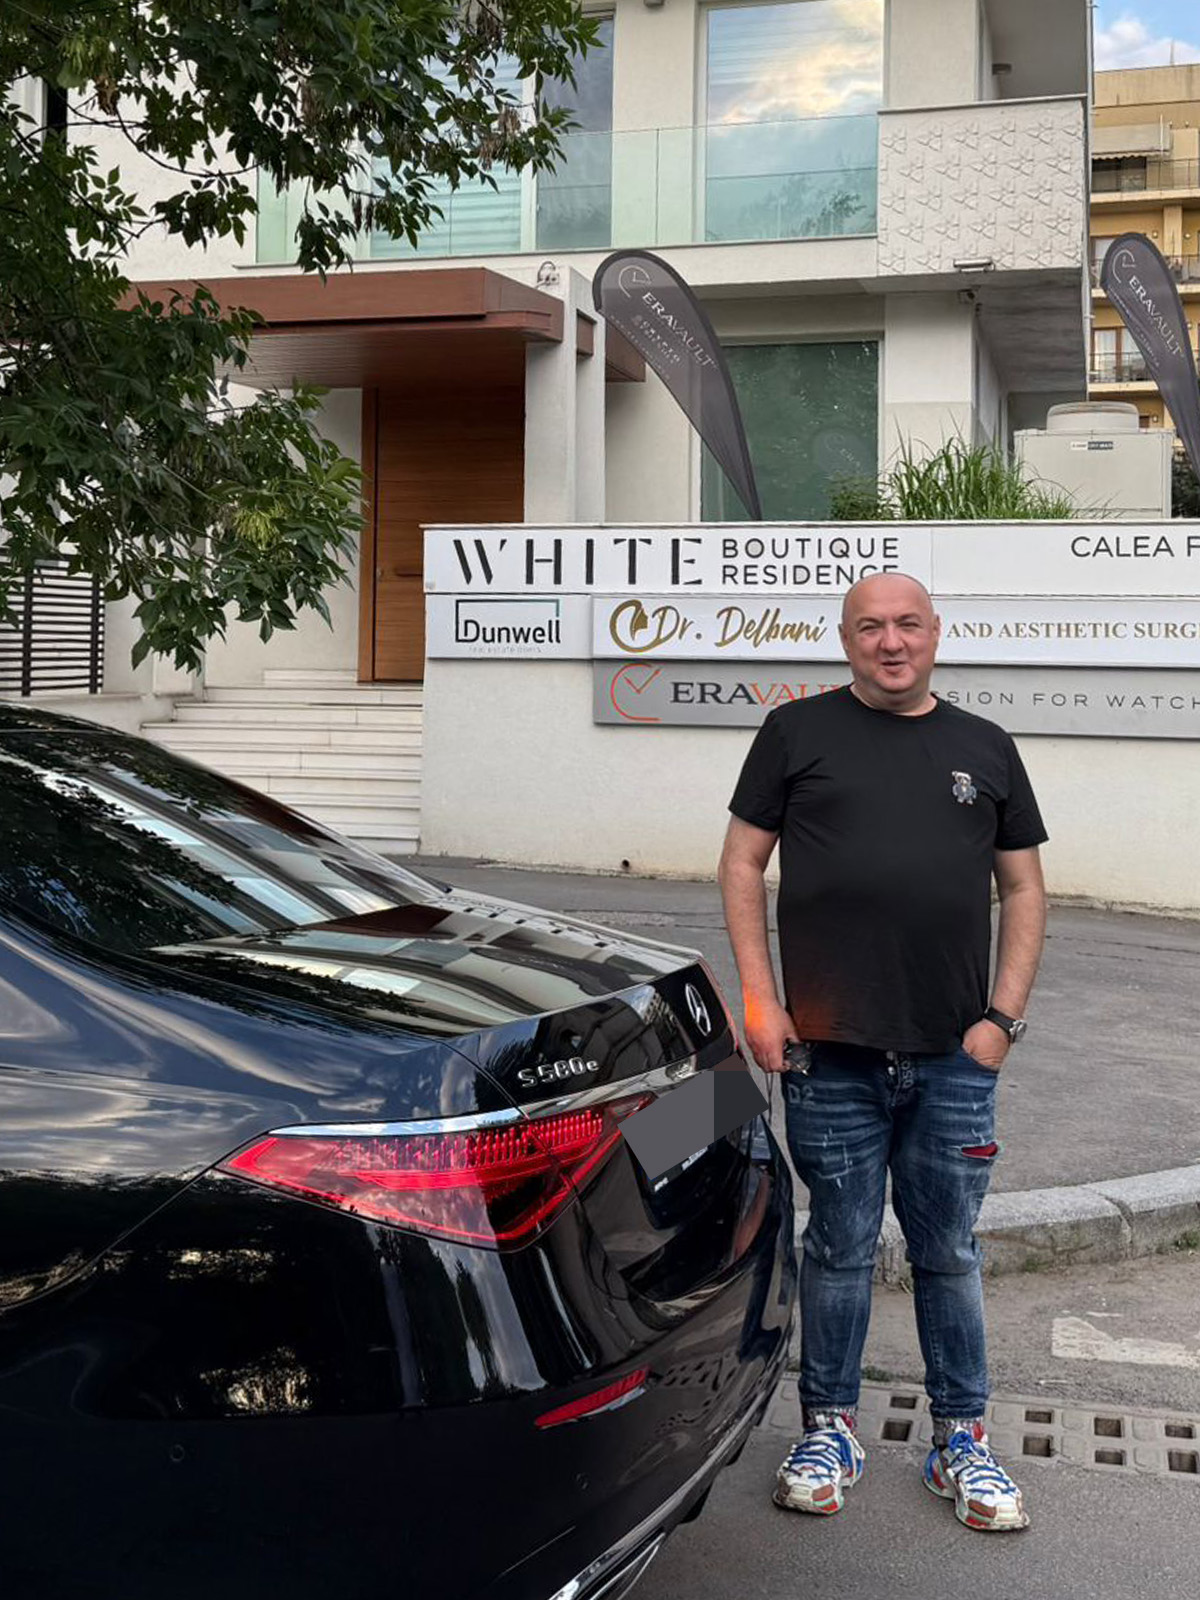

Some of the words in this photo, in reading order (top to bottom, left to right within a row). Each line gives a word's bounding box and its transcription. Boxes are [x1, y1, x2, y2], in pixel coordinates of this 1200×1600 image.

[641, 292, 714, 367] ERAVAULT
[1129, 275, 1182, 355] ERAVAULT
[453, 538, 703, 585] WHITE
[722, 538, 899, 559] BOUTIQUE
[1071, 536, 1175, 557] CALEA
[463, 619, 561, 643] Dunwell
[651, 605, 702, 647] Dr.
[947, 622, 993, 638] AND
[998, 622, 1127, 638] AESTHETIC
[1133, 622, 1200, 638] SURG
[930, 691, 1013, 705] SION
[1033, 693, 1088, 707] FOR
